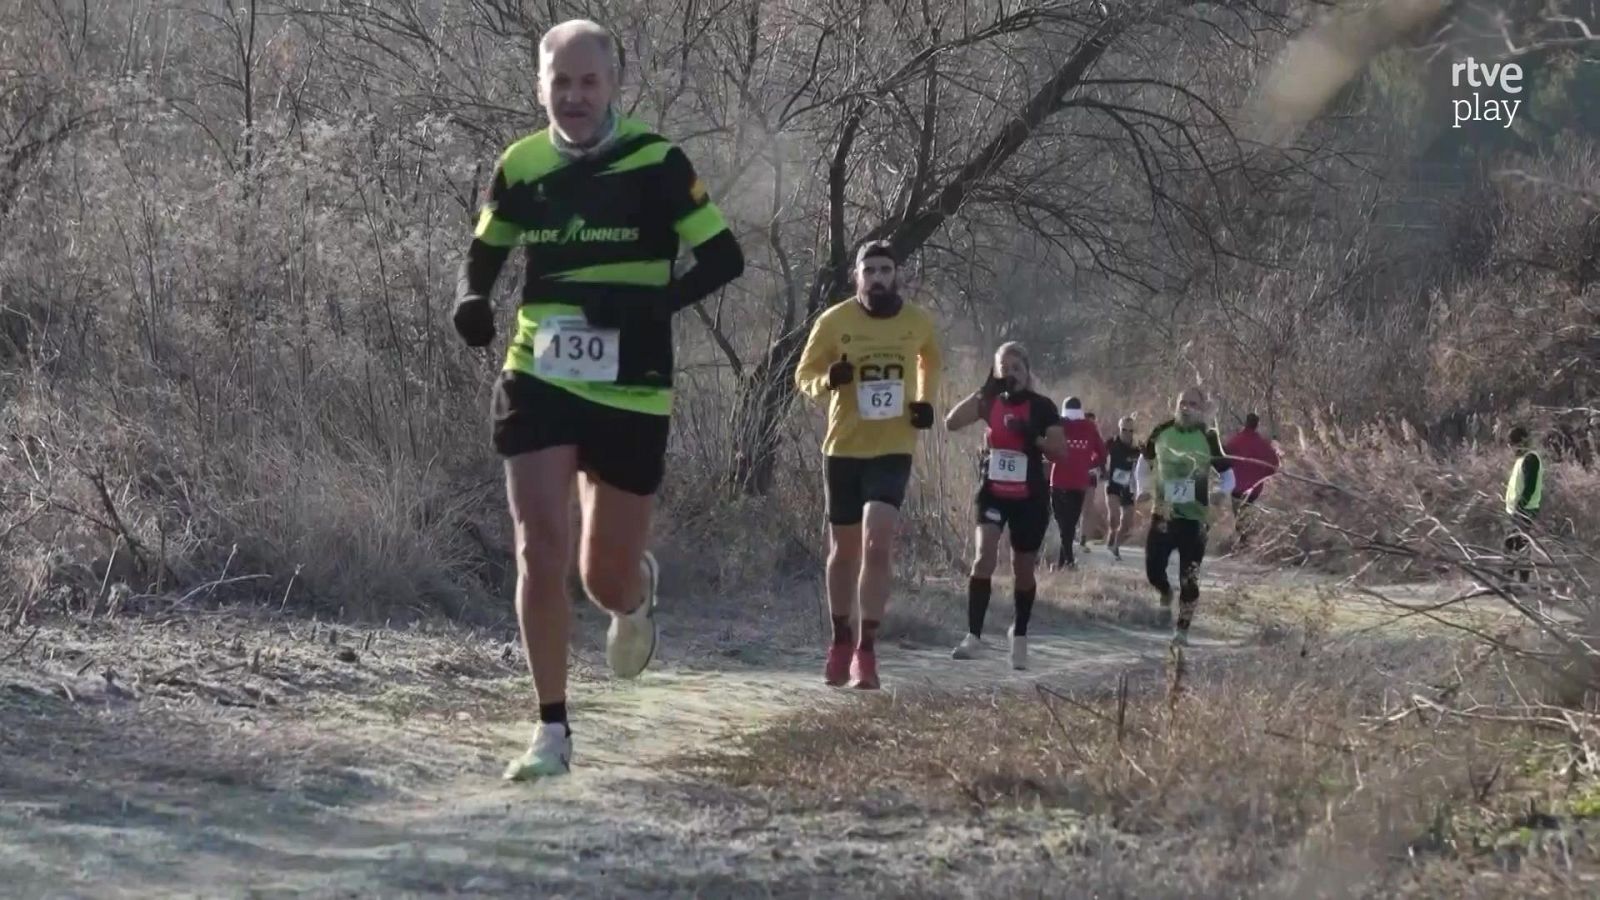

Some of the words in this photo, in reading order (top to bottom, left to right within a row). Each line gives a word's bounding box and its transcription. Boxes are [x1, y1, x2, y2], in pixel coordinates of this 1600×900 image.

[550, 334, 604, 361] 130
[871, 392, 893, 408] 62
[998, 459, 1016, 472] 96
